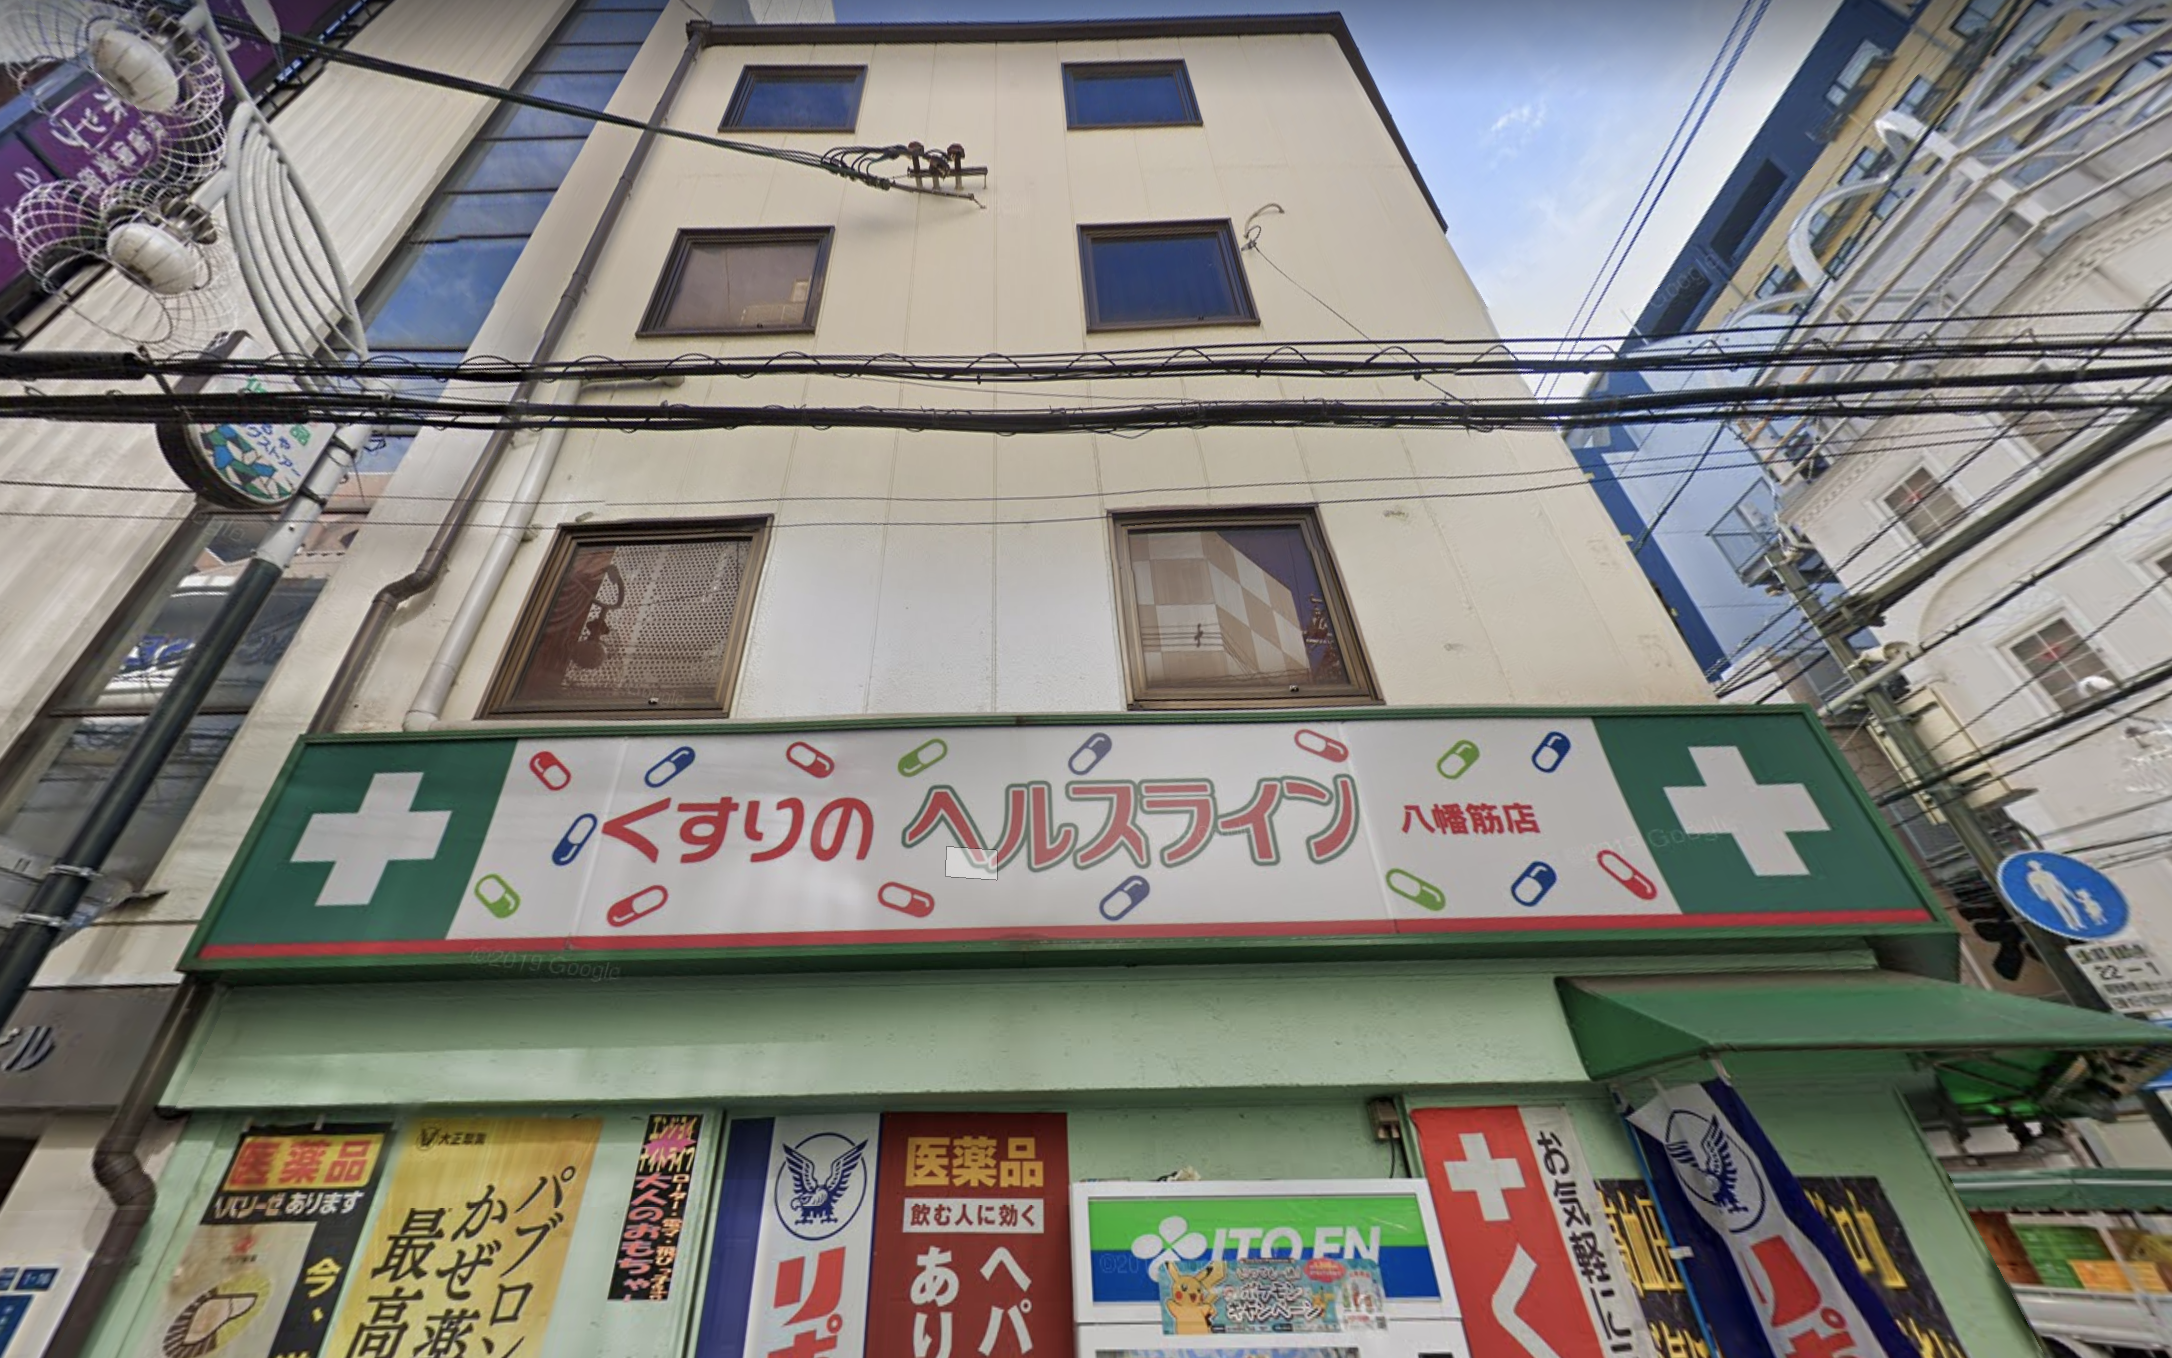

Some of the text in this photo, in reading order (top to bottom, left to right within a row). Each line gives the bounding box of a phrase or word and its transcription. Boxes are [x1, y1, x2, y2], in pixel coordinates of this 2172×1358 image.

[602, 773, 1541, 872] くすりの ヘルスライン 八幡筋店
[227, 1138, 373, 1186] 医薬品
[905, 1136, 1044, 1188] 医薬品
[910, 1203, 1035, 1228] 飲む人に効く
[1211, 1226, 1304, 1262] ITO
[1537, 1130, 1640, 1358] お気軽に
[348, 1208, 447, 1358] 最高
[910, 1245, 960, 1358] あり
[978, 1246, 1034, 1357] ヘパ
[1226, 1300, 1325, 1322] キャンペーン
[1240, 1281, 1304, 1302] ポケモン
[1491, 1242, 1563, 1358] く
